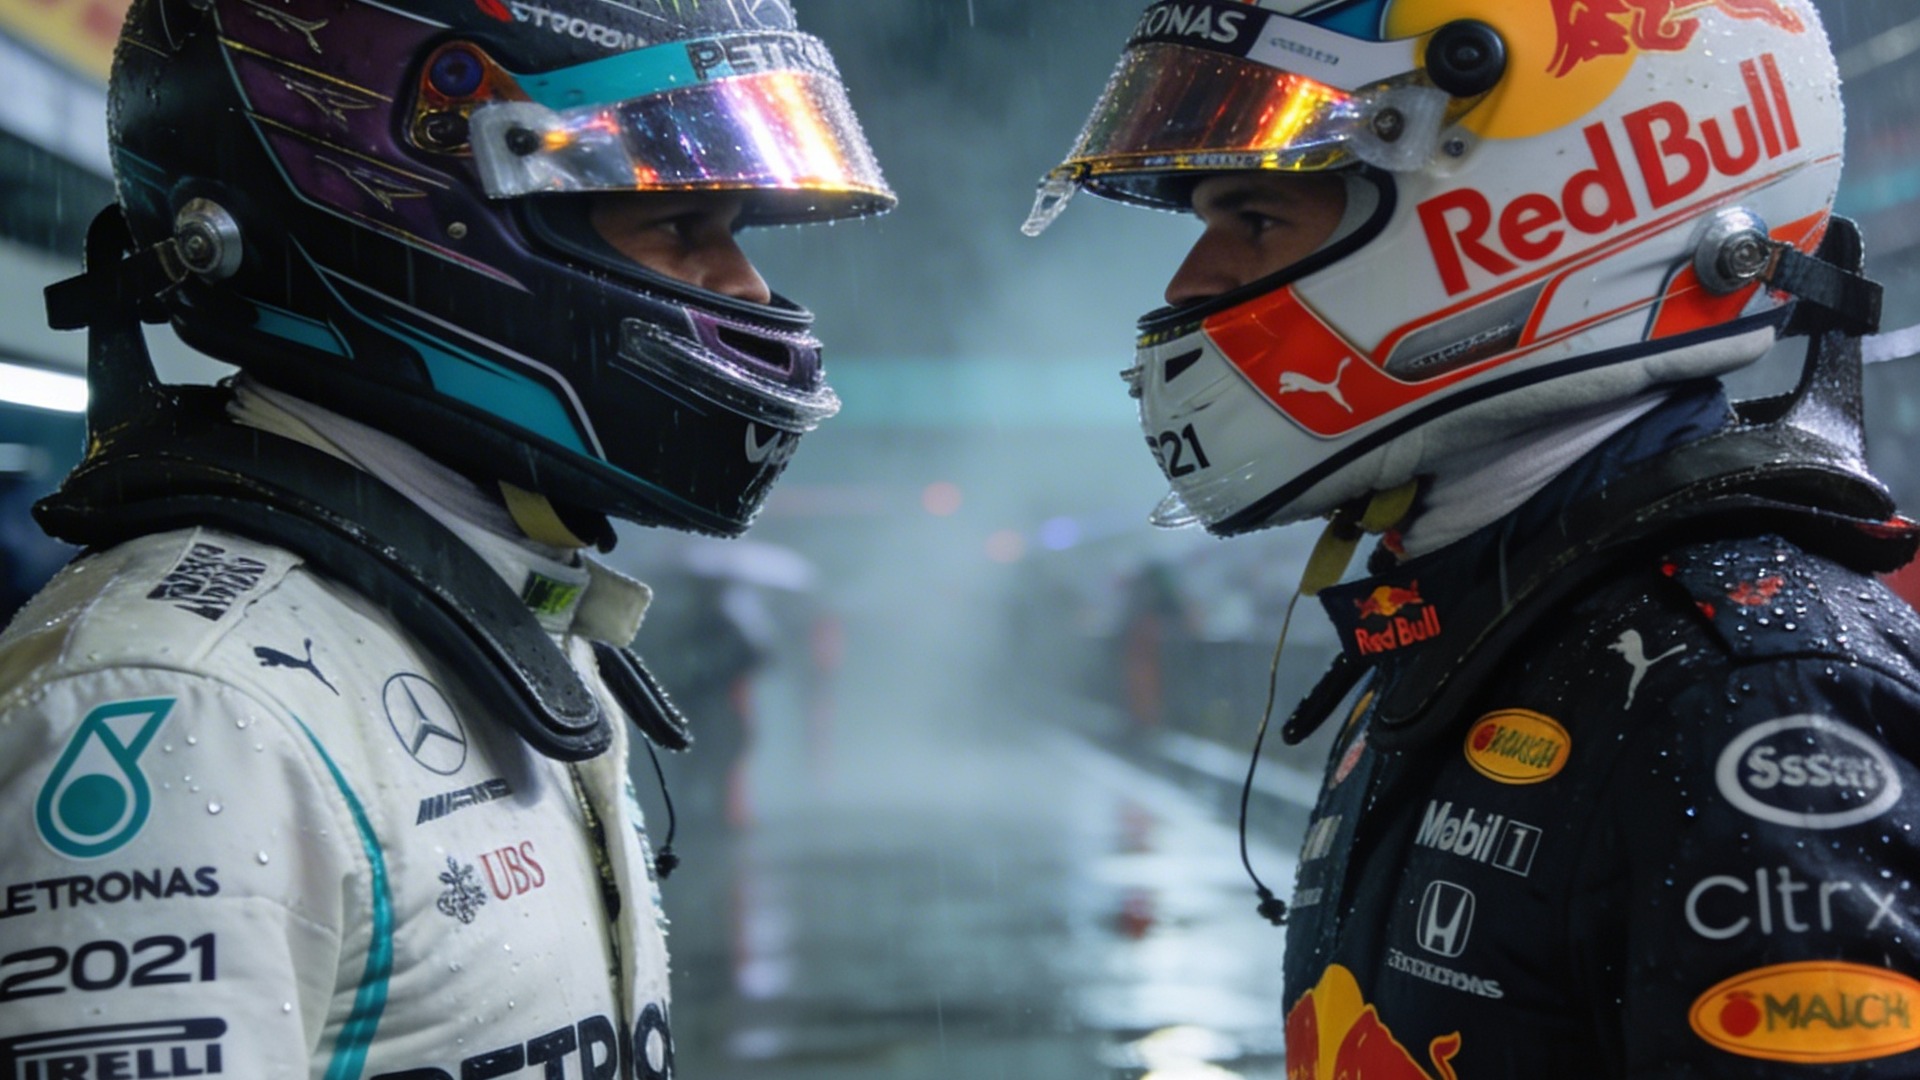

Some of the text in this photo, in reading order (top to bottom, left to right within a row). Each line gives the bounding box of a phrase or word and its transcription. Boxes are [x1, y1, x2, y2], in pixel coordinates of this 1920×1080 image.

[1416, 53, 1801, 297] Red Bull
[1394, 605, 1441, 646] Bull
[1415, 800, 1504, 862] Mobil
[0, 866, 220, 919] ETRONAS
[480, 841, 546, 901] UBS
[0, 932, 216, 1004] 2021
